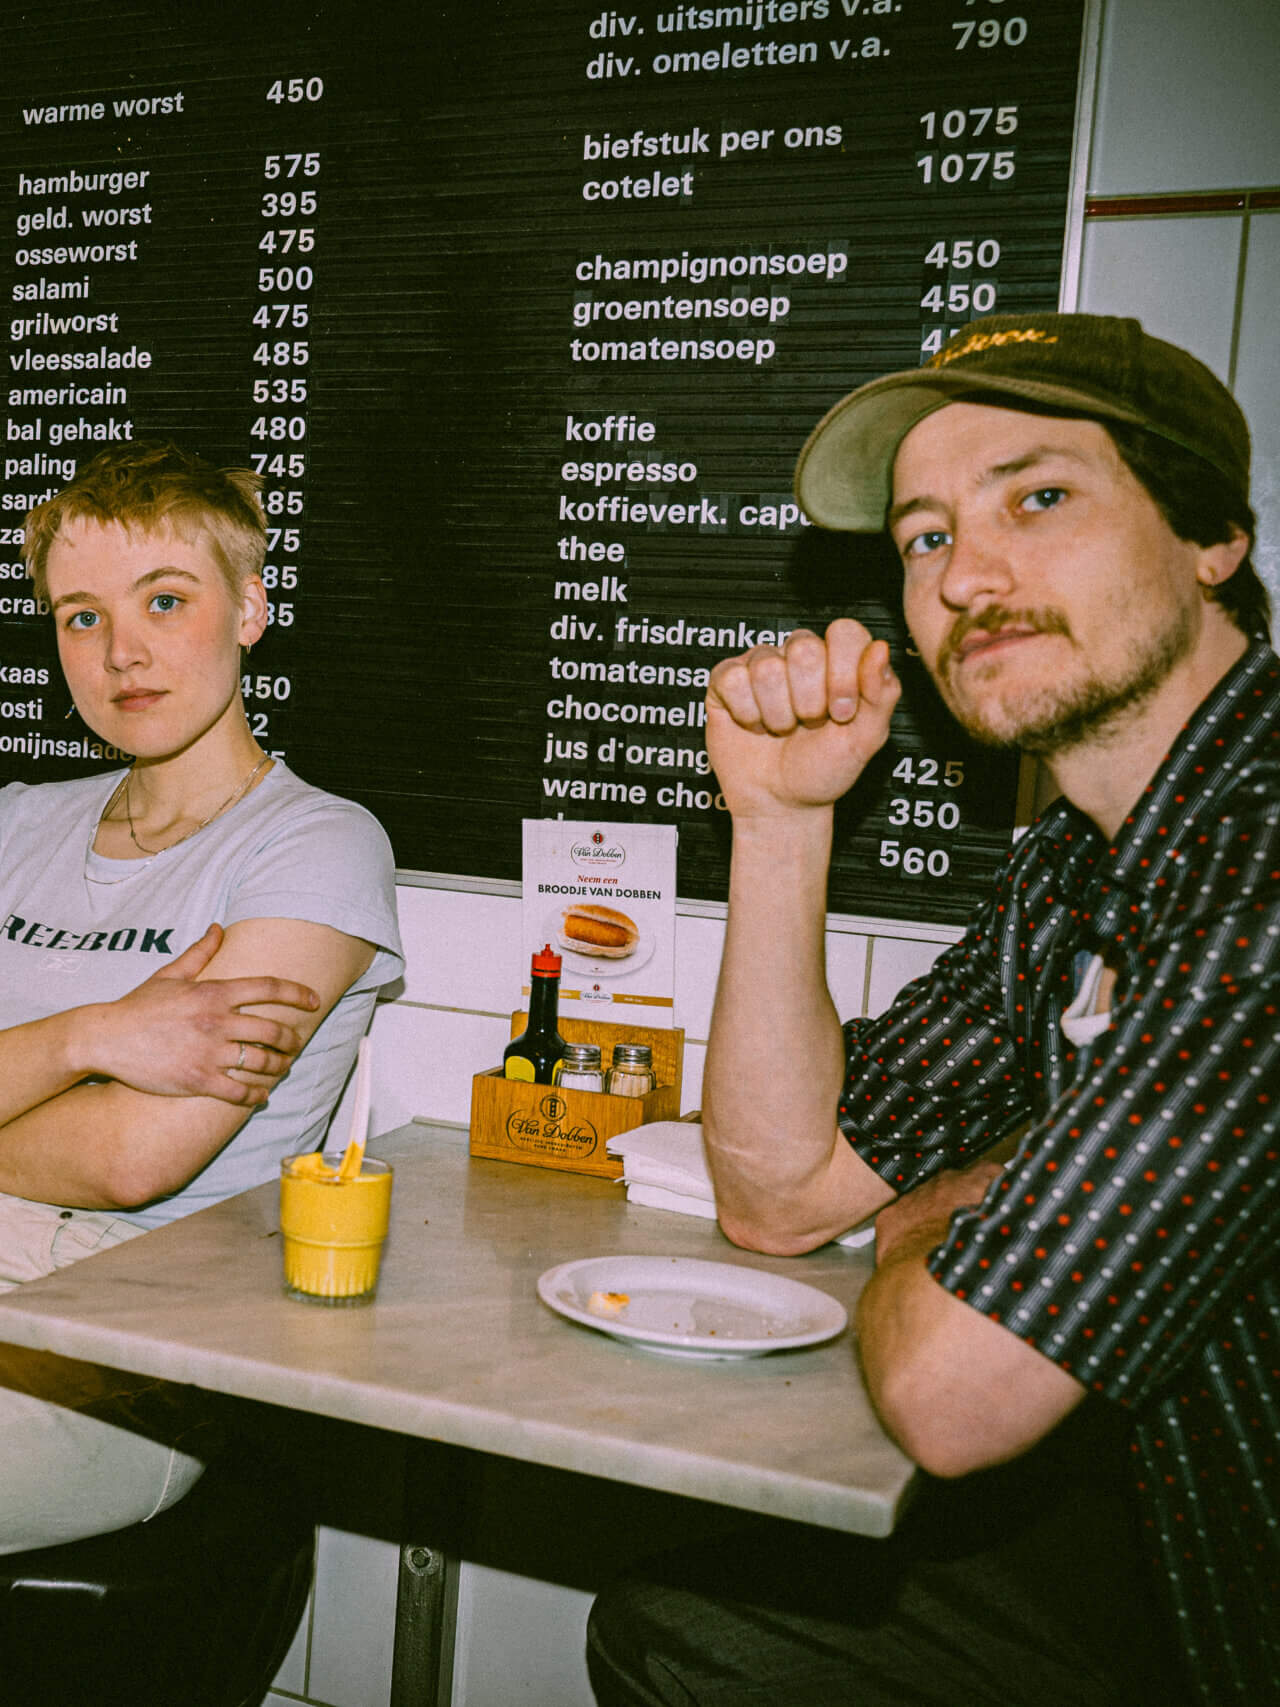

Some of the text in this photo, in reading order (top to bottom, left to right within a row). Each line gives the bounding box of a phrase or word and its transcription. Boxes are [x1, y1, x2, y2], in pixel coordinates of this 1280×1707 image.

[589, 11, 643, 38] div.
[657, 0, 829, 32] uitsmijters
[586, 17, 1027, 79] div. omeletten v.a. 790
[23, 77, 323, 124] warme worst 450
[584, 107, 1017, 160] biefstuk per ons 1075
[19, 153, 320, 195] hamburger 575
[583, 152, 1015, 200] cotelet 1075
[17, 191, 316, 236] geld. worst 395
[16, 229, 314, 265] osseworst 475
[576, 240, 1000, 283] champignonsoep 450
[12, 266, 313, 301] salami 500
[574, 283, 996, 327] groentensoep 450
[11, 304, 308, 340] grilworst 475
[10, 342, 308, 370] vleessalade 485
[570, 337, 775, 364] tomatensoep
[9, 379, 306, 405] americain 535
[7, 417, 305, 445] bal gehakt 480
[566, 416, 655, 441] koffie
[5, 453, 304, 481] paling 745
[562, 461, 697, 486] espresso
[1, 488, 304, 514] sard 85
[560, 496, 726, 524] koffieverk.
[0, 527, 301, 551] za 75
[557, 536, 624, 562] thee
[262, 566, 298, 588] 85
[555, 576, 627, 602] melk
[551, 615, 603, 641] div.
[549, 654, 710, 688] tomatensa
[544, 733, 711, 774] jus d'orang
[891, 756, 965, 788] 425
[543, 778, 730, 811] warme choc
[888, 799, 959, 829] 350
[880, 841, 949, 876] 560
[538, 884, 661, 900] BROODJE VAN DOBBEN
[577, 874, 618, 885] Neem een
[512, 1119, 592, 1144] Van Dobben
